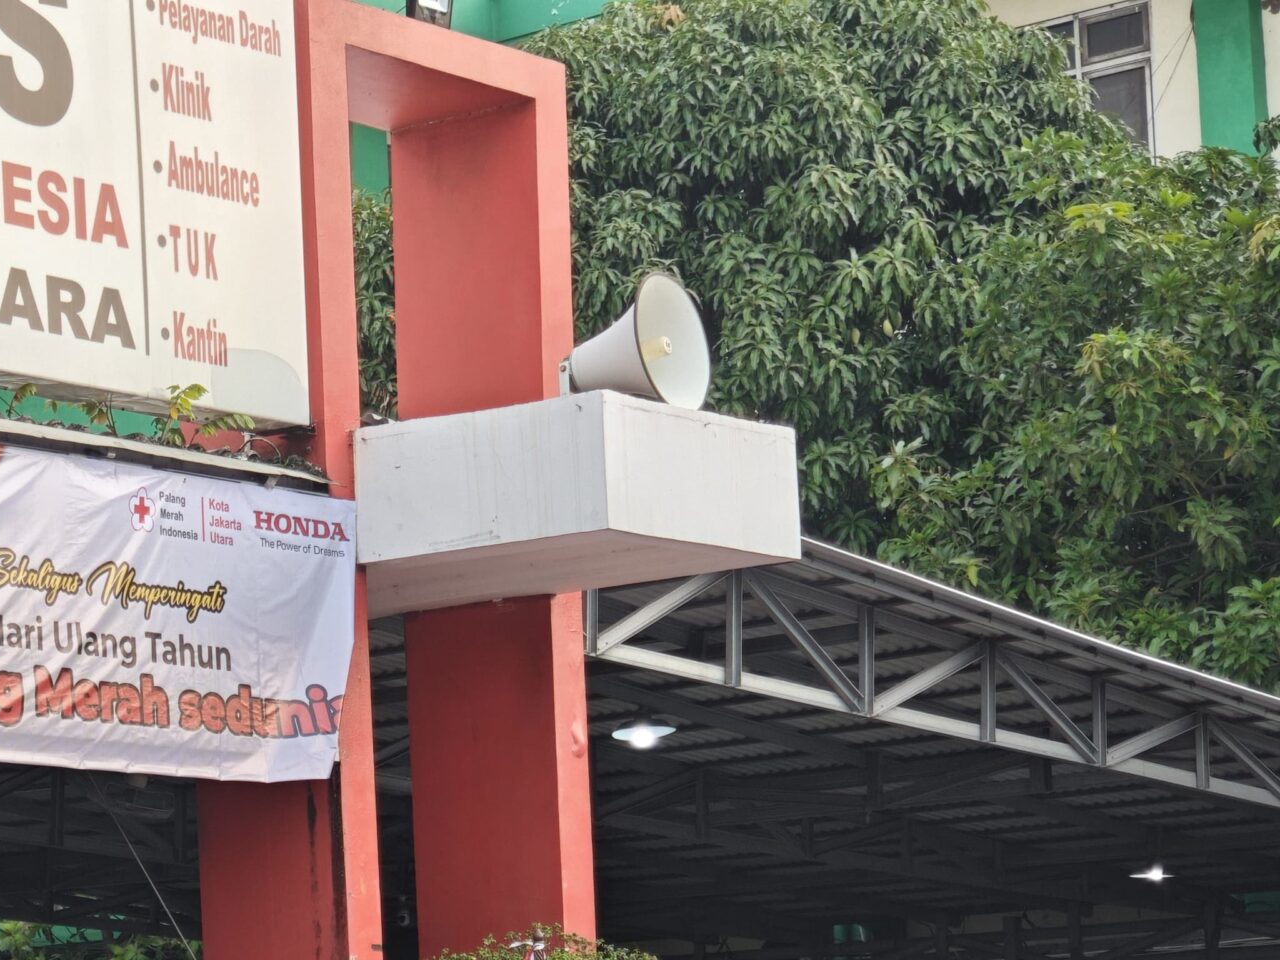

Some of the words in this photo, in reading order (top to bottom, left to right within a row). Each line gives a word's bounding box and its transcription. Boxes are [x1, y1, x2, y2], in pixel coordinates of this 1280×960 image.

[159, 0, 236, 45] Pelayanan
[238, 10, 282, 57] Darah
[161, 62, 212, 122] Klinik
[167, 140, 260, 208] Ambulance
[169, 224, 219, 281] TUK
[172, 310, 229, 368] Kantin
[159, 491, 186, 507] Palang
[160, 508, 184, 521] Merah
[208, 498, 230, 513] Kota
[159, 526, 199, 541] Indonesia
[209, 515, 242, 531] Jakarta
[210, 531, 234, 546] Utara
[253, 510, 350, 542] HONDA
[260, 537, 275, 549] The
[276, 541, 301, 554] Power
[302, 544, 312, 554] of
[313, 545, 346, 558] Dreams
[86, 561, 227, 623] Memperingati
[53, 621, 137, 667] Ulang
[145, 632, 232, 672] Tahun
[33, 664, 170, 729] Merah
